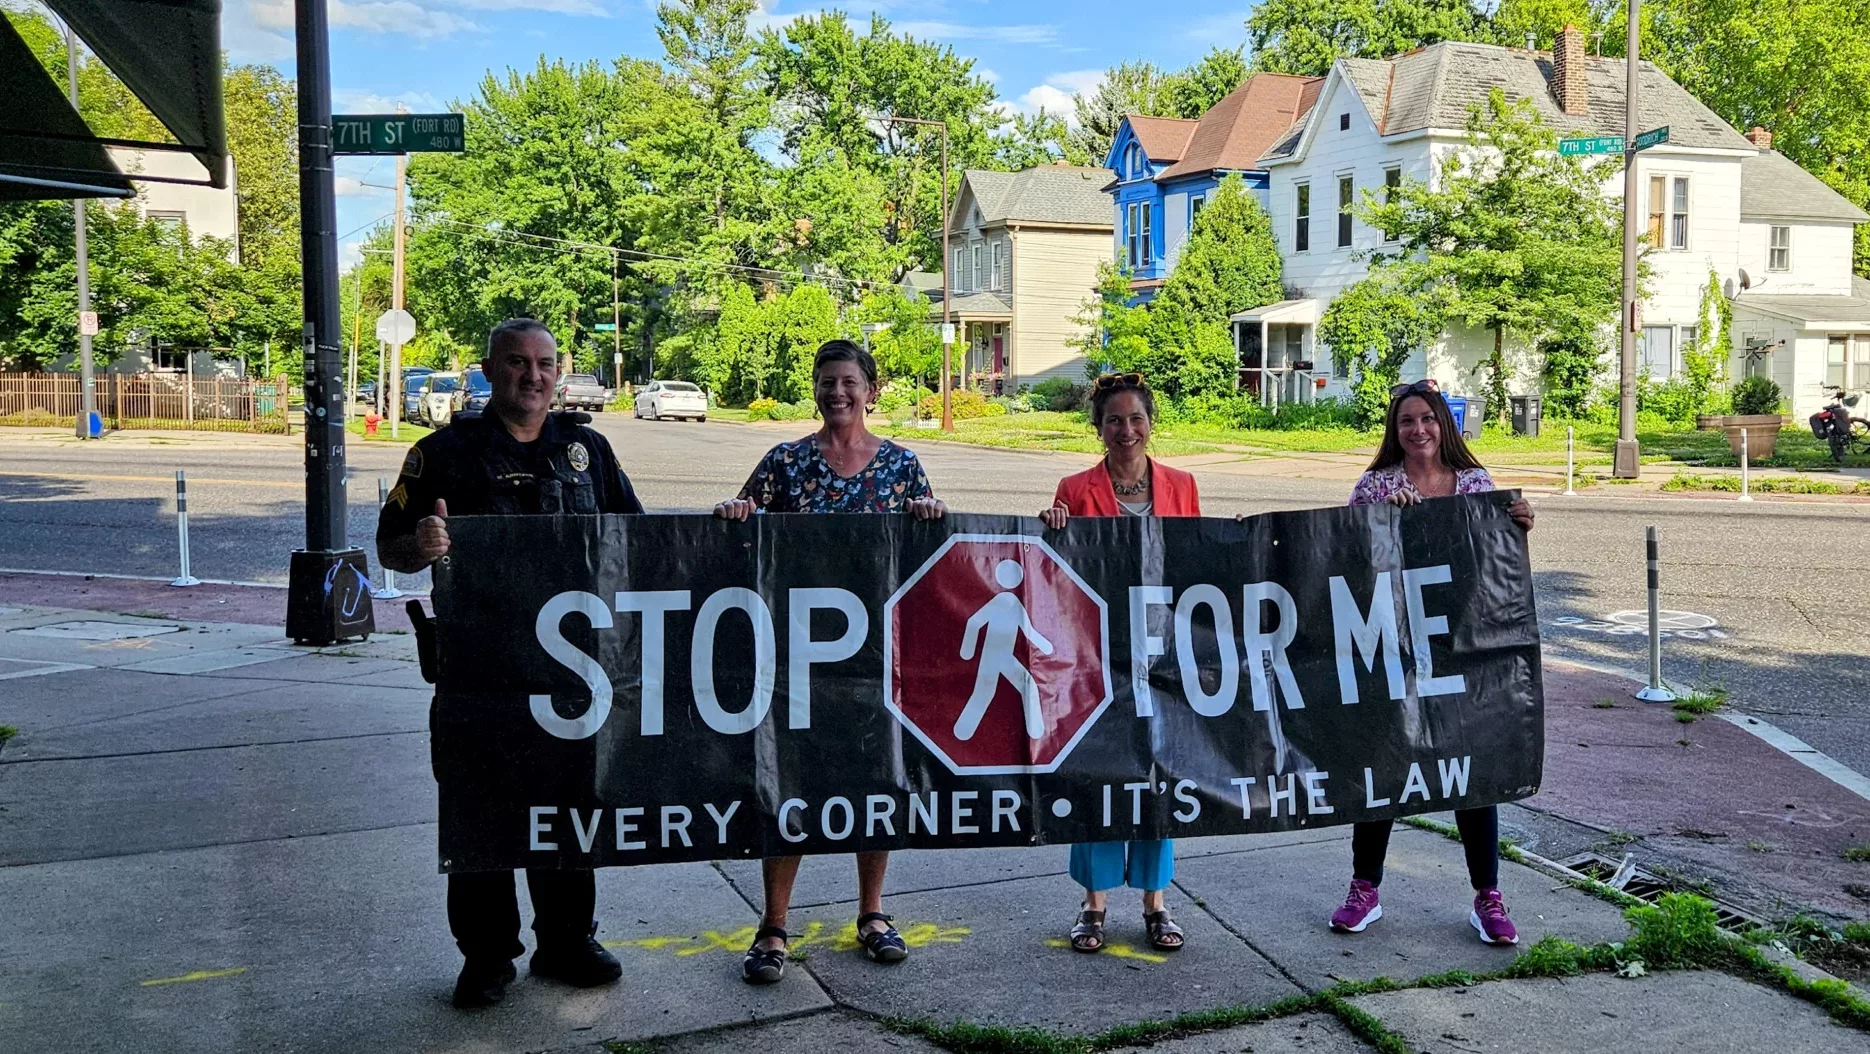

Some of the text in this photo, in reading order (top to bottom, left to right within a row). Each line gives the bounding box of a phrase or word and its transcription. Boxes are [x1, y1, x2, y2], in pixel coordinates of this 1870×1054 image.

[337, 121, 406, 145] 7TH ST
[412, 117, 460, 134] (FORT RD)
[429, 136, 461, 149] 480 W
[1562, 140, 1596, 152] 7TH ST
[529, 564, 1466, 741] STOP FOR ME
[529, 755, 1471, 853] EVERY CORNER IT'S THE LAW
